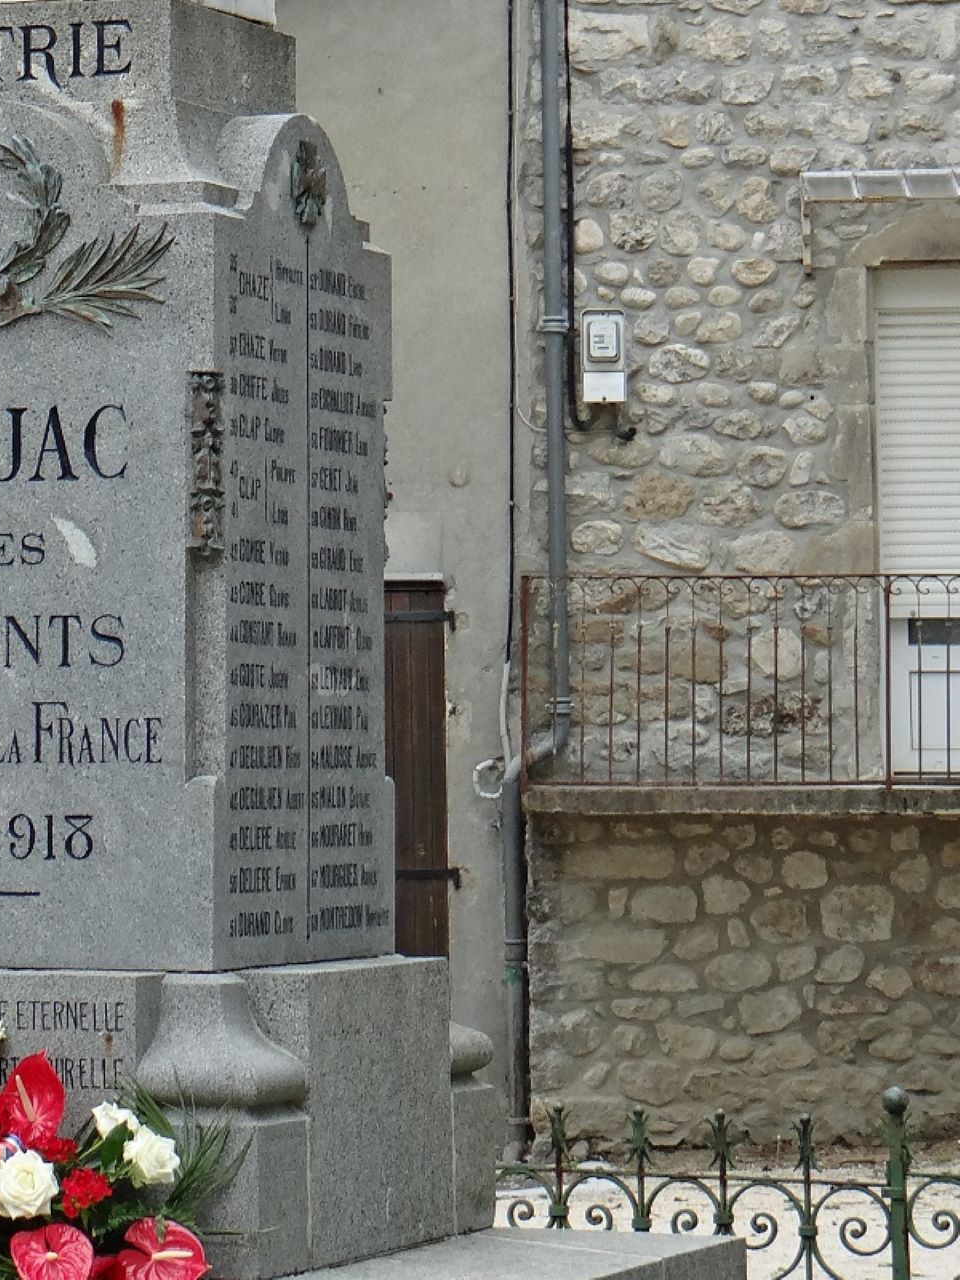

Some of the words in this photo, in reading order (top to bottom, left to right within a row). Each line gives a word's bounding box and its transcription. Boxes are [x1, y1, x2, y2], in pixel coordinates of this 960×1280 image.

[239, 271, 269, 301] CHAZE
[239, 332, 265, 360] CHAZE
[32, 701, 163, 764] FRANCE
[16, 1000, 125, 1032] ETERNELLE
